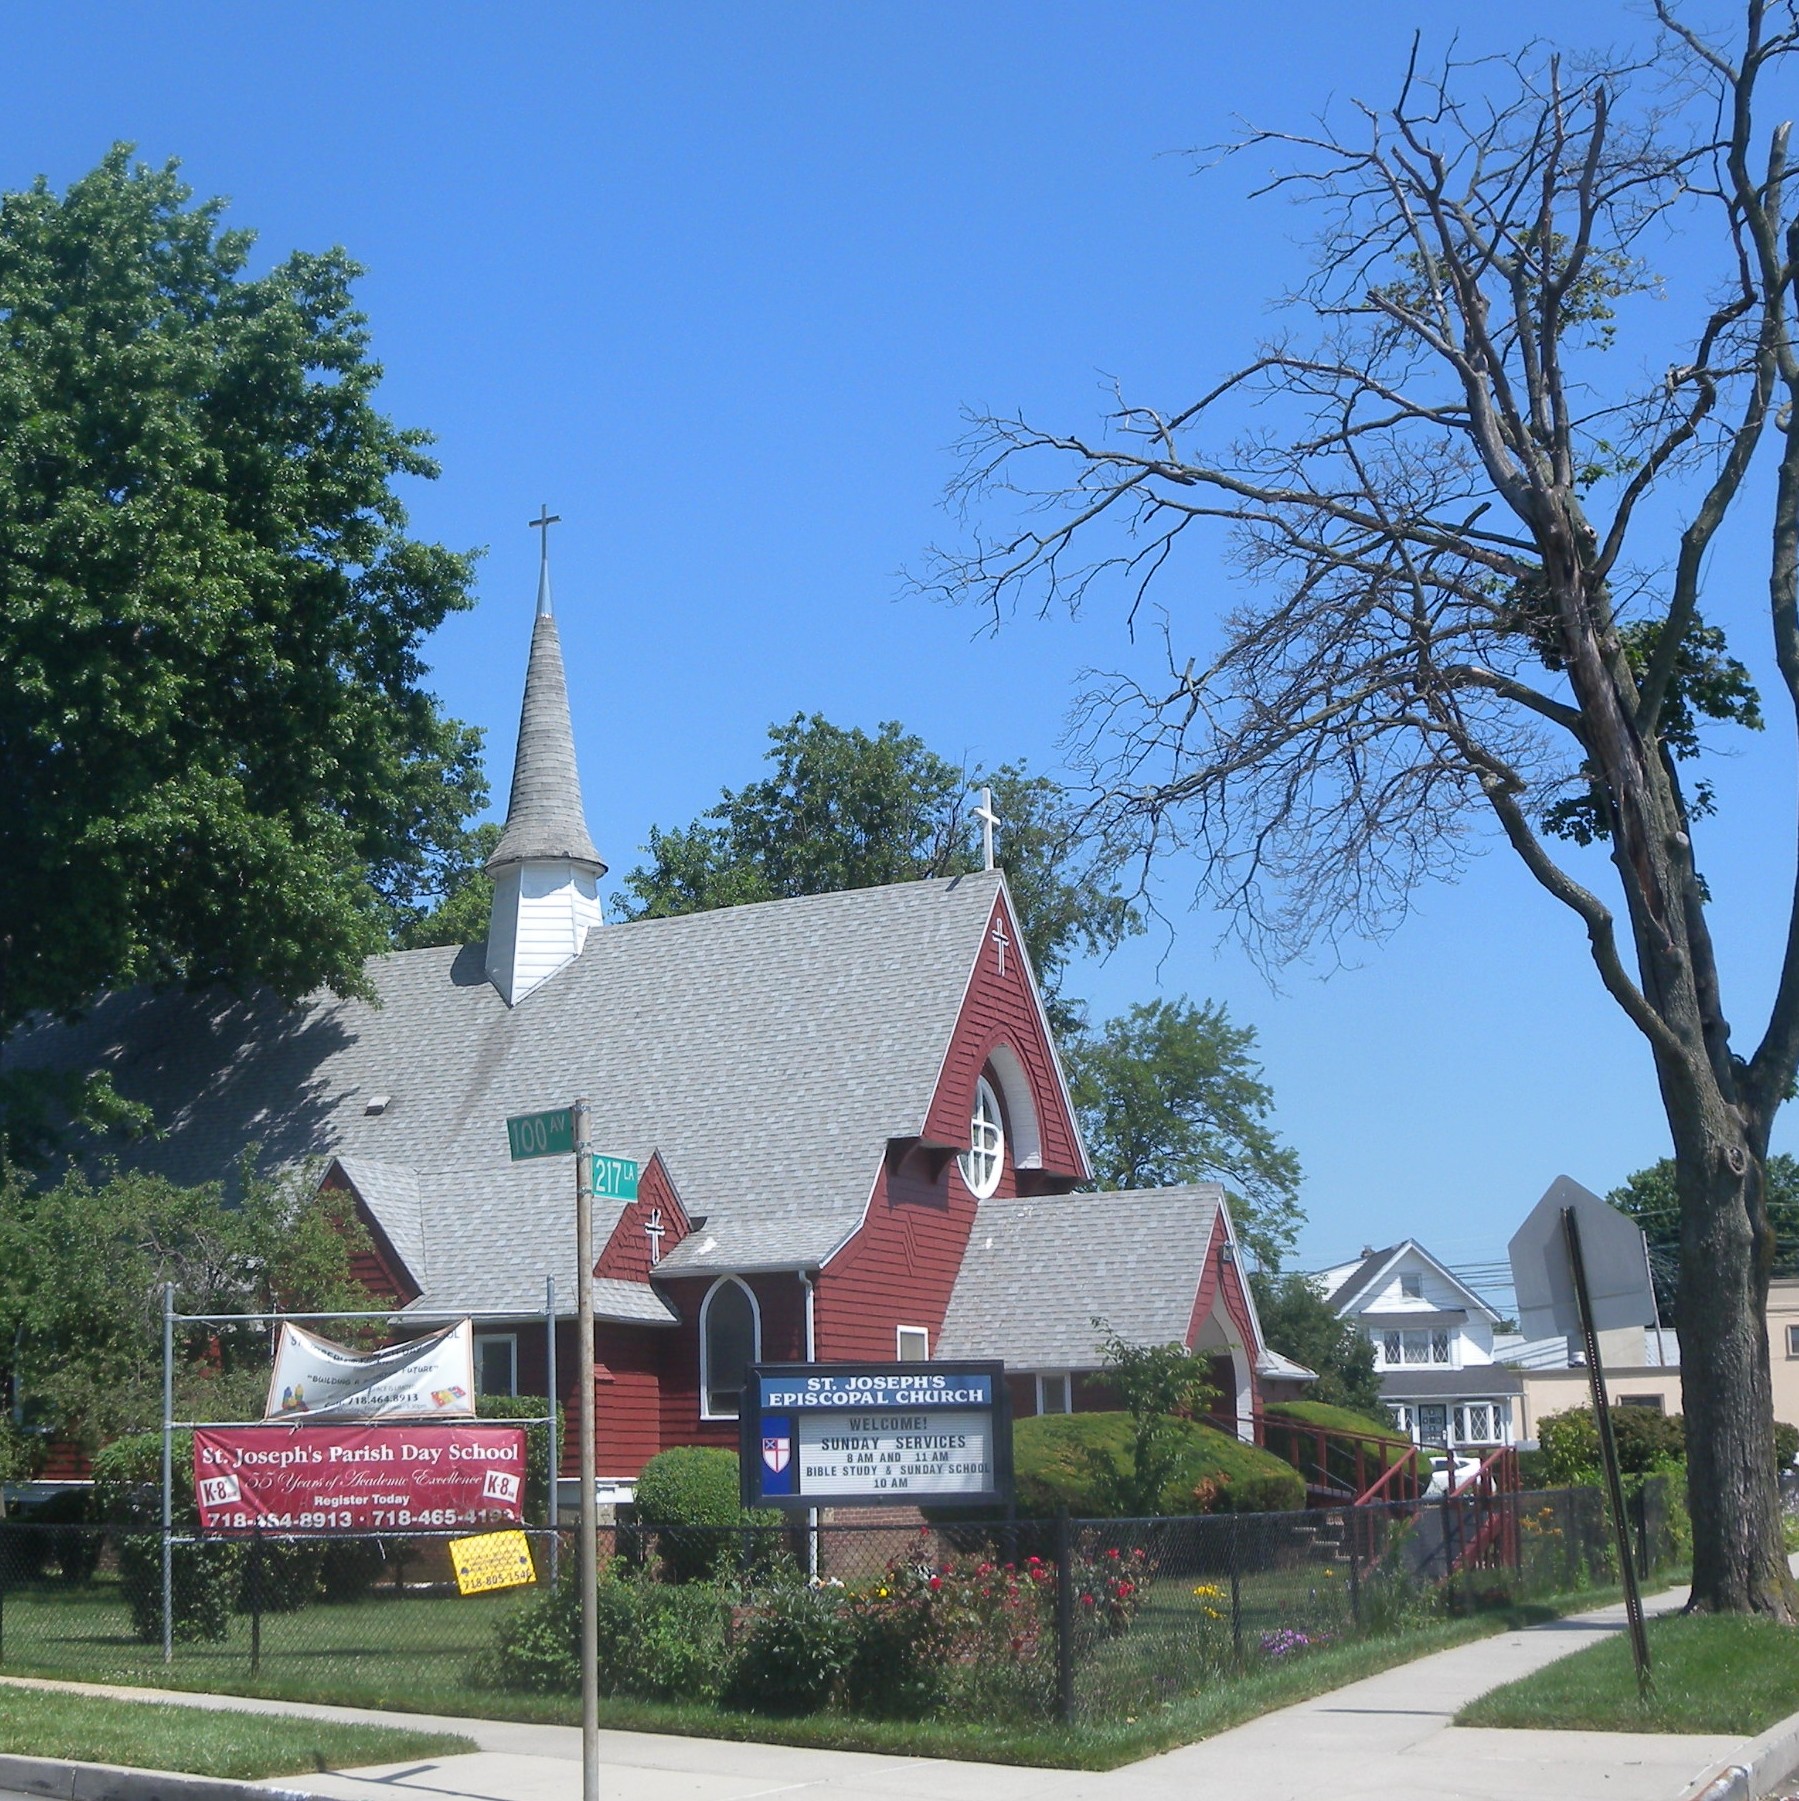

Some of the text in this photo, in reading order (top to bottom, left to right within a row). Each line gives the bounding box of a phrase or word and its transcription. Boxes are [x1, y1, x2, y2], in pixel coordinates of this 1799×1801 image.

[512, 1115, 565, 1153] 100 AV
[595, 1159, 635, 1194] 217 LA
[807, 1375, 946, 1391] ST. JOSEPH'S
[769, 1389, 984, 1406] EPISCOPAL CHURCH
[850, 1417, 928, 1431] WELCOME!
[821, 1435, 966, 1450] SUNDAY SERVICES
[202, 1443, 518, 1468] St. Joseph's Parish Day School
[847, 1451, 949, 1463] 8 AM AND 11 AM
[806, 1462, 990, 1477] BIBLE STUDY & SUNDAY SCHOOL
[277, 1472, 323, 1493] Years
[325, 1472, 339, 1491] of
[339, 1470, 408, 1489] Academic
[411, 1469, 482, 1486] Excellence
[487, 1474, 509, 1495] K-8
[874, 1477, 908, 1489] 10 AM
[203, 1482, 227, 1502] K-8
[314, 1493, 410, 1508] Register Today
